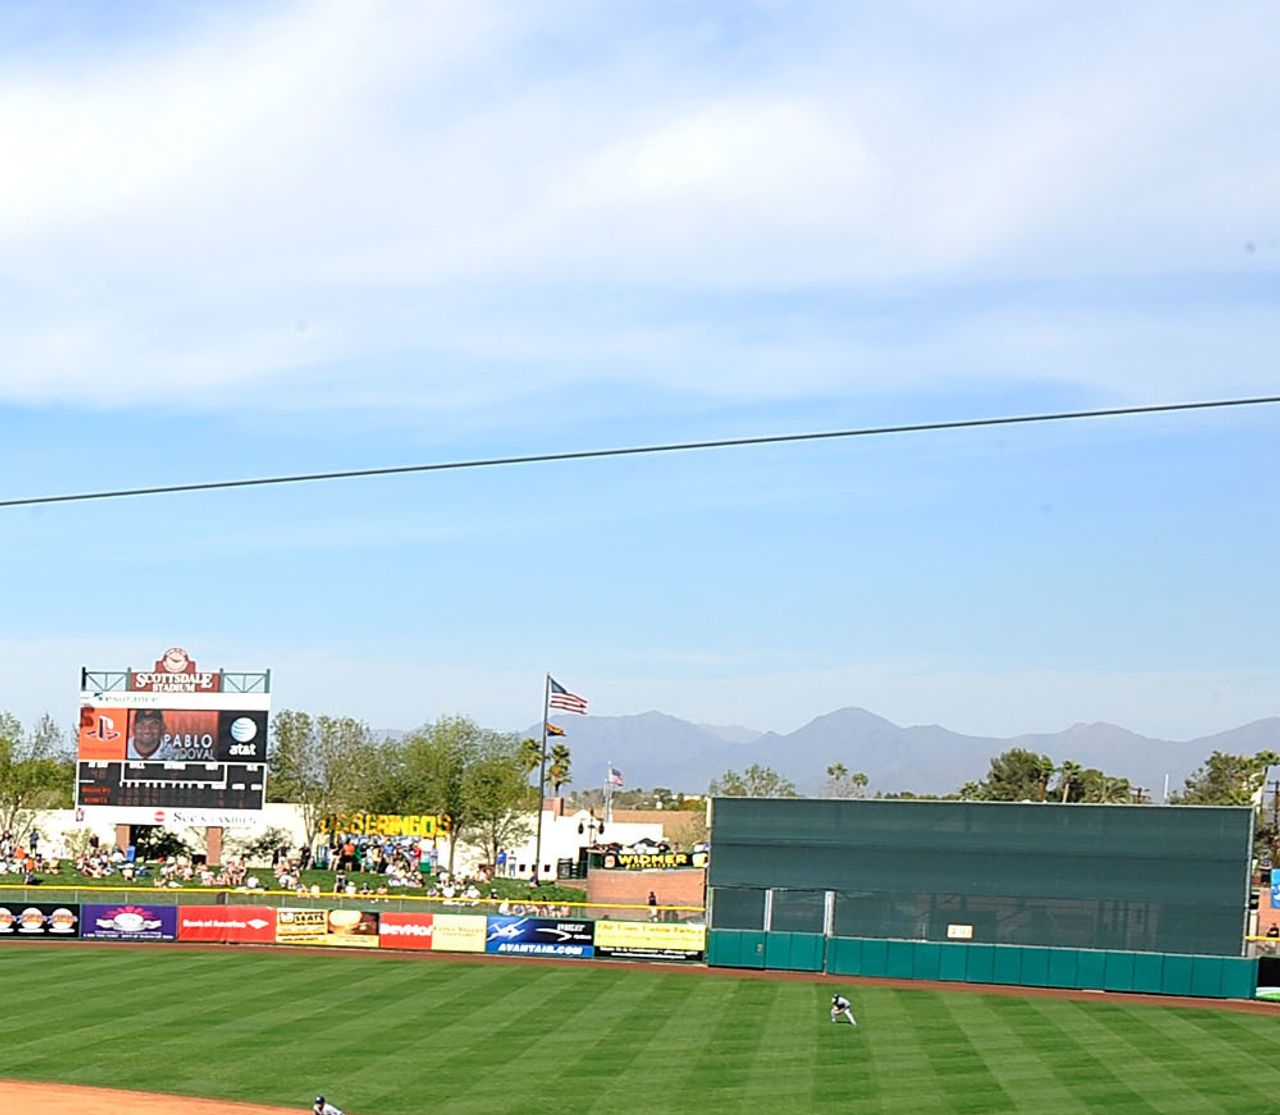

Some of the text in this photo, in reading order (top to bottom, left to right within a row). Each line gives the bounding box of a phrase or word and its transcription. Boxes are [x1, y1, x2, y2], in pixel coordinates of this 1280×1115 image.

[135, 673, 213, 689] SCOTTSDALE
[152, 684, 196, 692] STADIUM
[163, 734, 213, 748] PABLO
[618, 854, 688, 864] WIDMER
